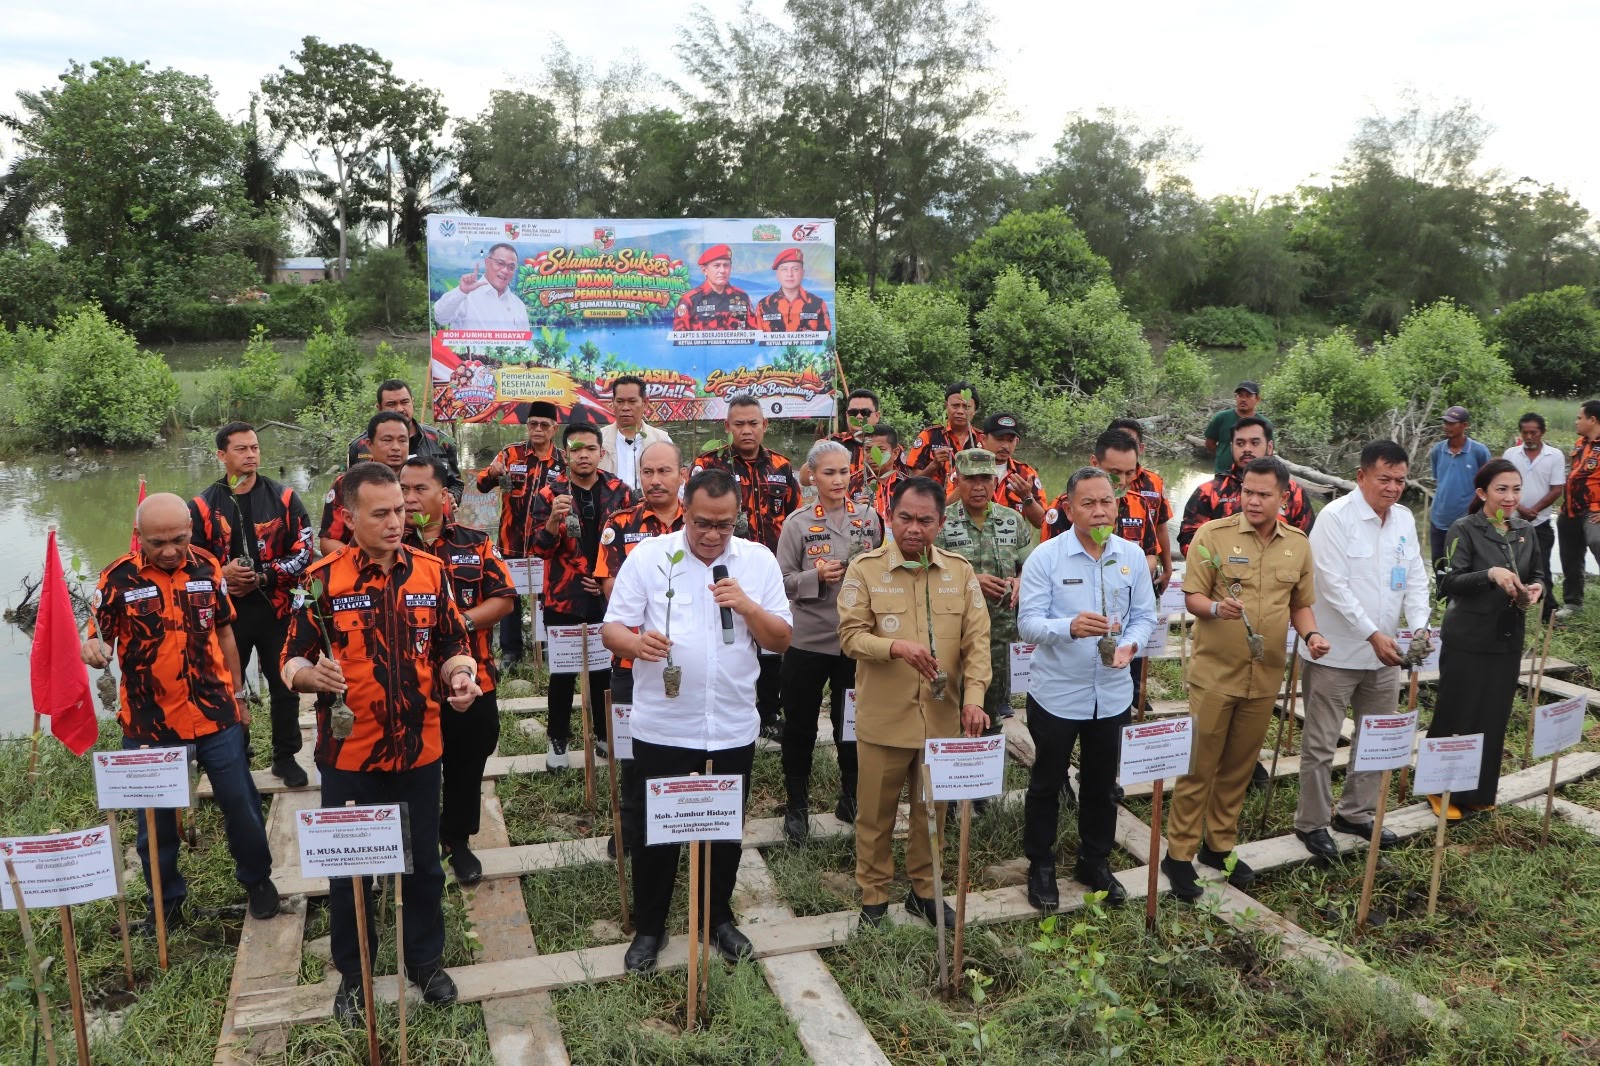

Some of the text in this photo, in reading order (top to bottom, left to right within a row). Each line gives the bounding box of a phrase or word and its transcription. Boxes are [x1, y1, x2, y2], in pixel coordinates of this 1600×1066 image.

[539, 246, 669, 277] Selamat & Sukses
[525, 273, 686, 292] PENANAMAN 100.000 POHON PELINDUNG
[574, 289, 612, 301] PEMUDA
[612, 289, 663, 304] PANCASILA
[570, 301, 640, 310] SE SUMATERA UTARA
[501, 372, 550, 380] Pemeriksaan
[501, 388, 564, 397] Bagi Masyarakat
[749, 383, 767, 397] Kita
[766, 382, 815, 402] Berpantang
[164, 751, 181, 763] 67
[718, 779, 736, 791] 67
[374, 808, 393, 821] 67
[674, 811, 705, 819] Jumhur
[706, 809, 736, 818] Hidayat
[82, 830, 105, 847] 67
[317, 847, 342, 855] MUSA
[344, 844, 398, 853] RAJEKSHAH
[58, 882, 94, 892] SOEWONDO
